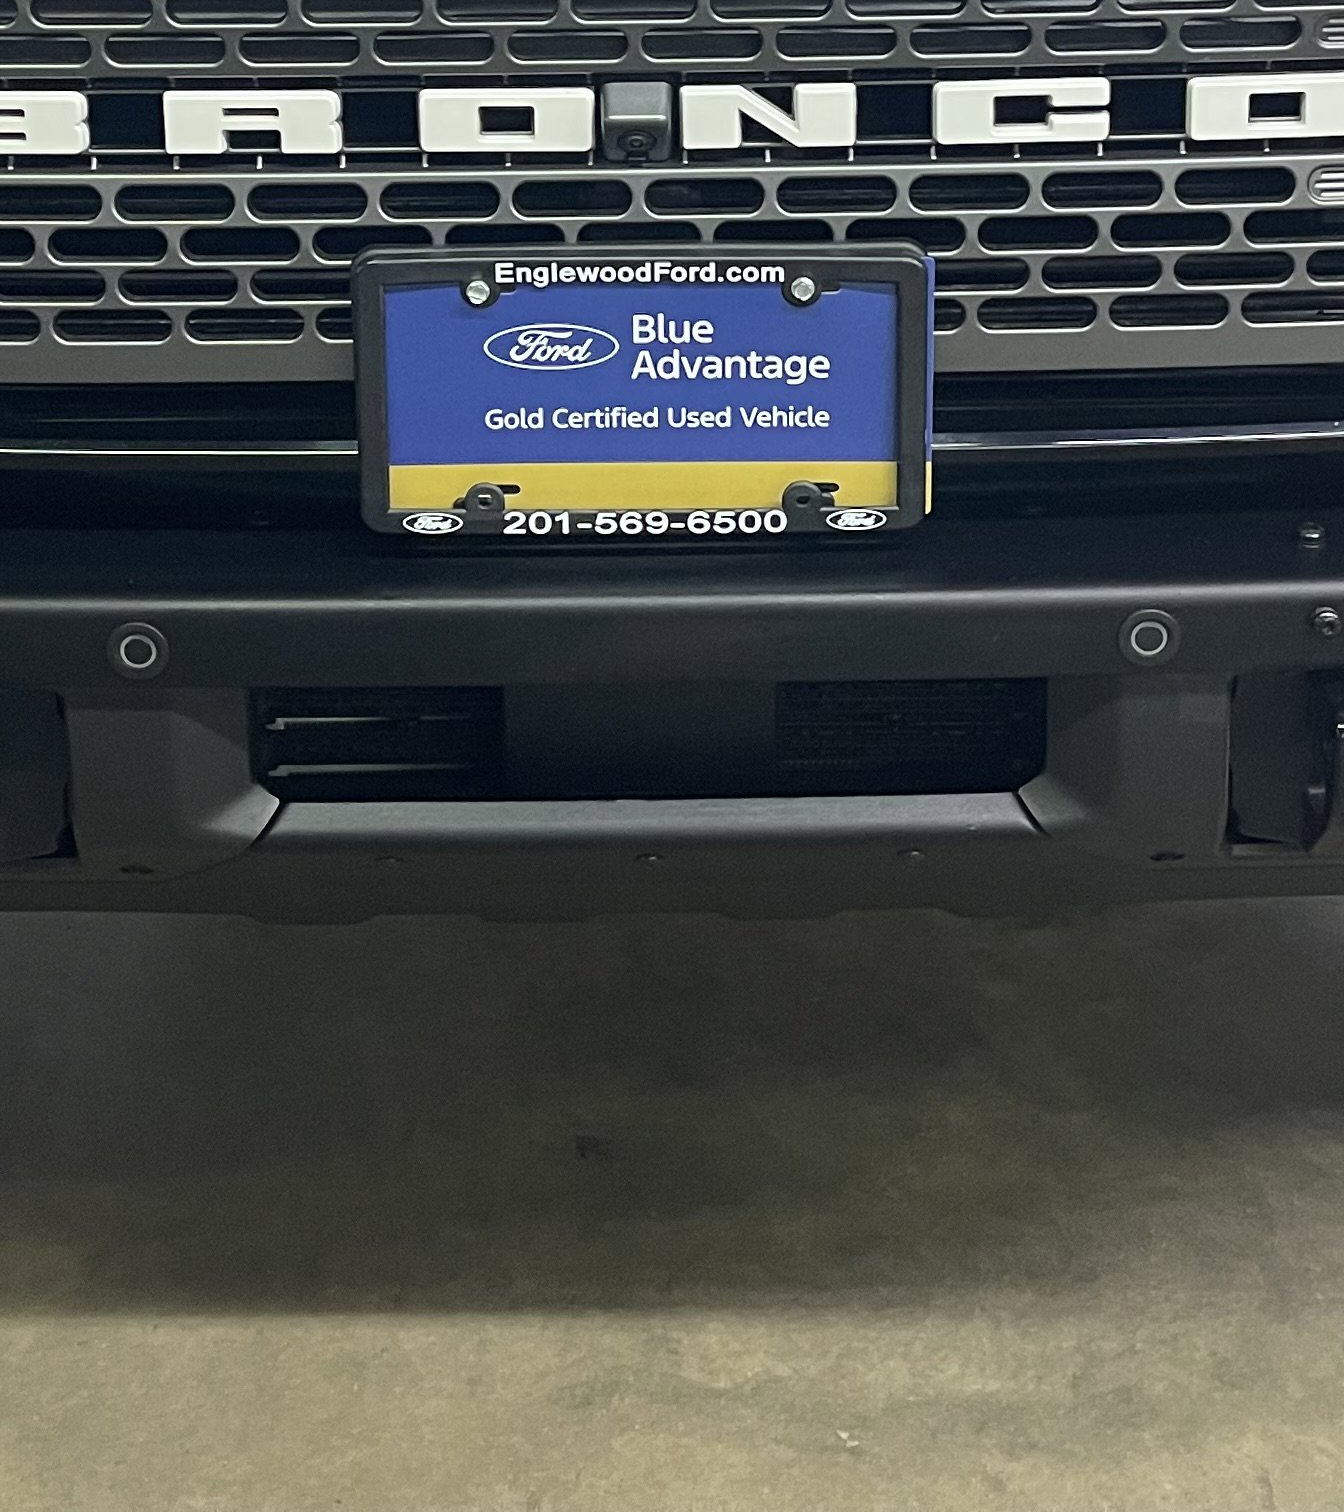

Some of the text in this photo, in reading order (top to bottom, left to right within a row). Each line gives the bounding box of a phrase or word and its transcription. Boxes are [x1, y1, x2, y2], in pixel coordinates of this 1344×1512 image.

[494, 261, 785, 285] EnglewoodFord.com
[631, 312, 714, 345] Blue
[630, 349, 832, 385] Advantage
[484, 405, 831, 430] Gold Certified Used Vehicle
[502, 509, 789, 536] 201-569-6500
